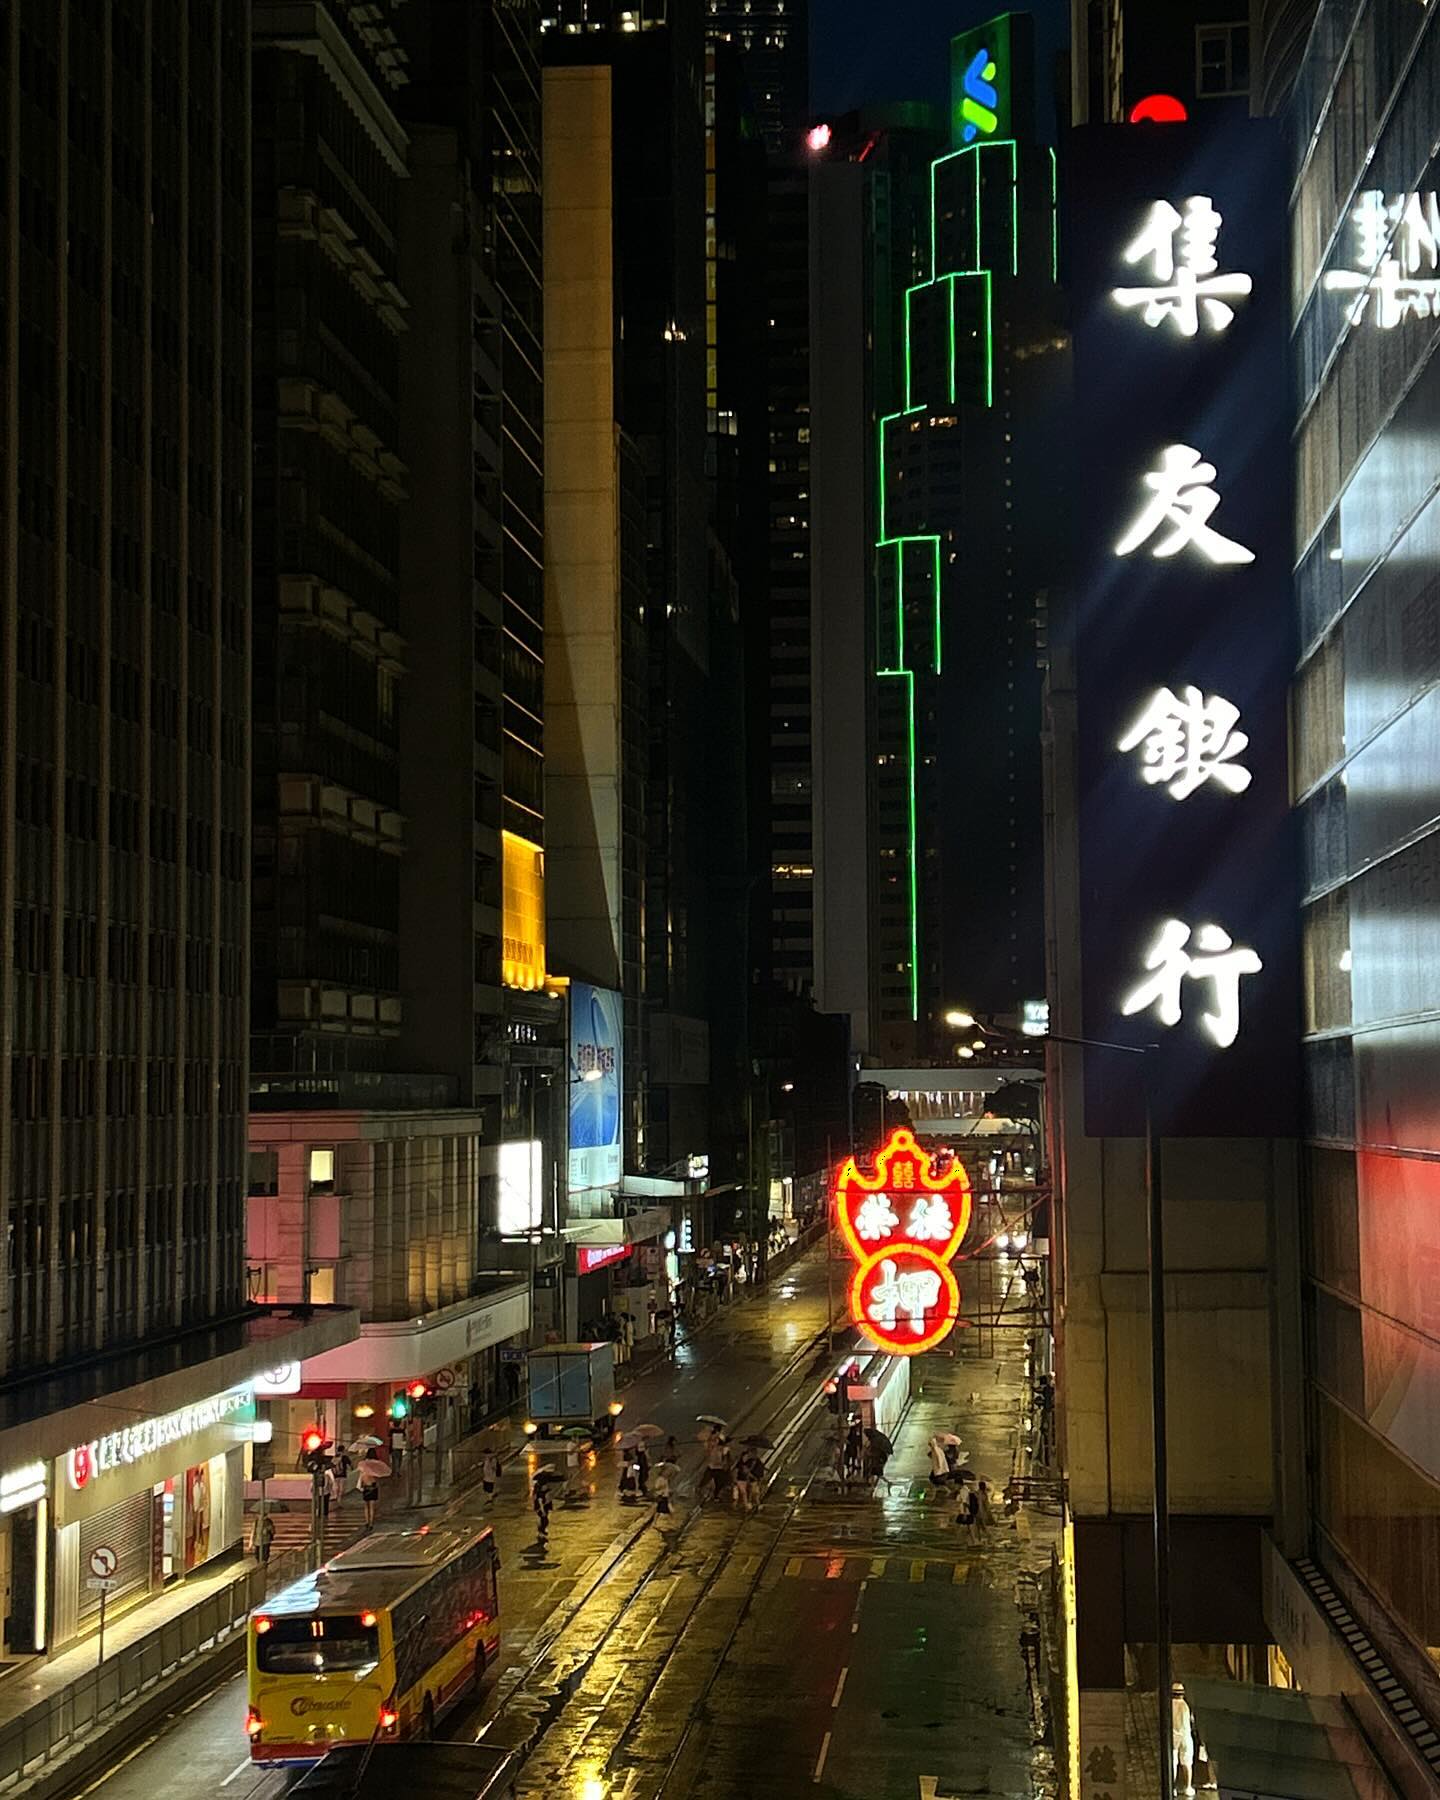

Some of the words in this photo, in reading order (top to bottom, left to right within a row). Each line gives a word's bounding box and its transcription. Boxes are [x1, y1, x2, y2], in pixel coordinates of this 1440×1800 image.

[1111, 194, 1263, 1049] 集友銀行
[868, 1259, 941, 1335] 押
[312, 1621, 324, 1637] 11
